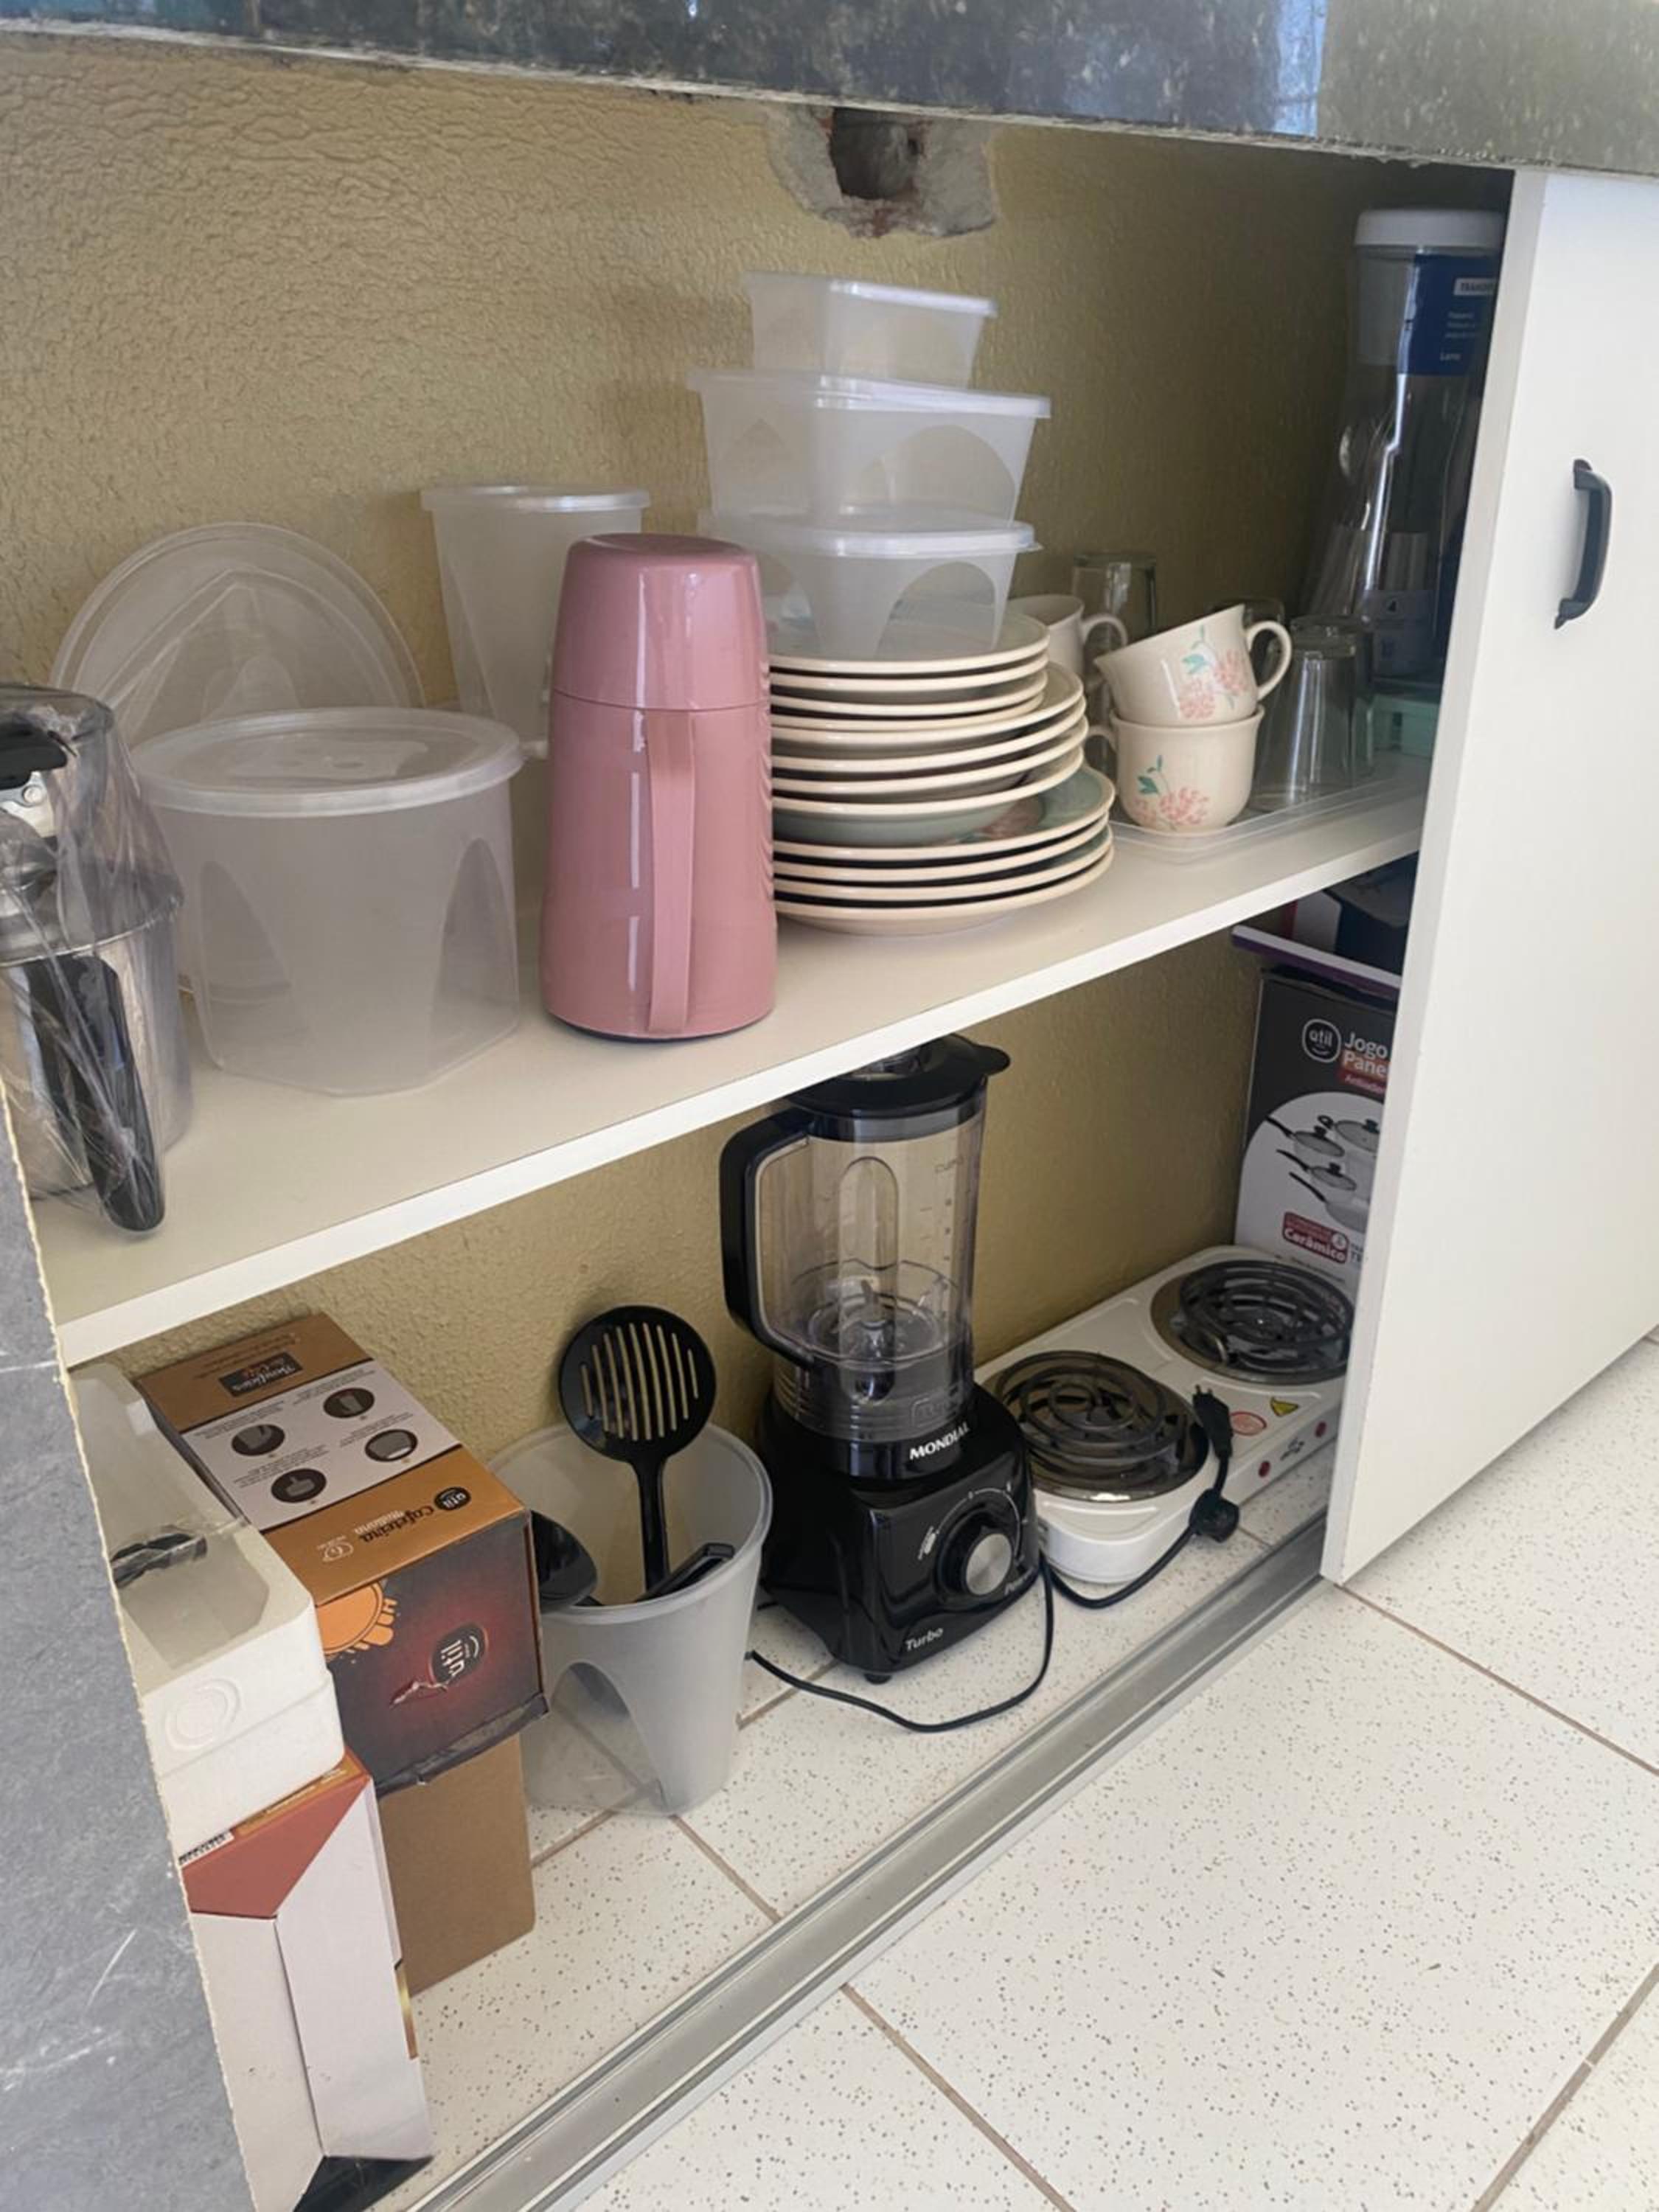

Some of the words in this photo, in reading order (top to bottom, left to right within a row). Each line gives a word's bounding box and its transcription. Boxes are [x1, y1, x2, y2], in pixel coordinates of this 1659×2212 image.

[1344, 1032, 1388, 1060] Jogo
[1341, 1050, 1389, 1078] Pane
[909, 1422, 970, 1460] MONDIAL
[906, 1628, 943, 1651] Turbo
